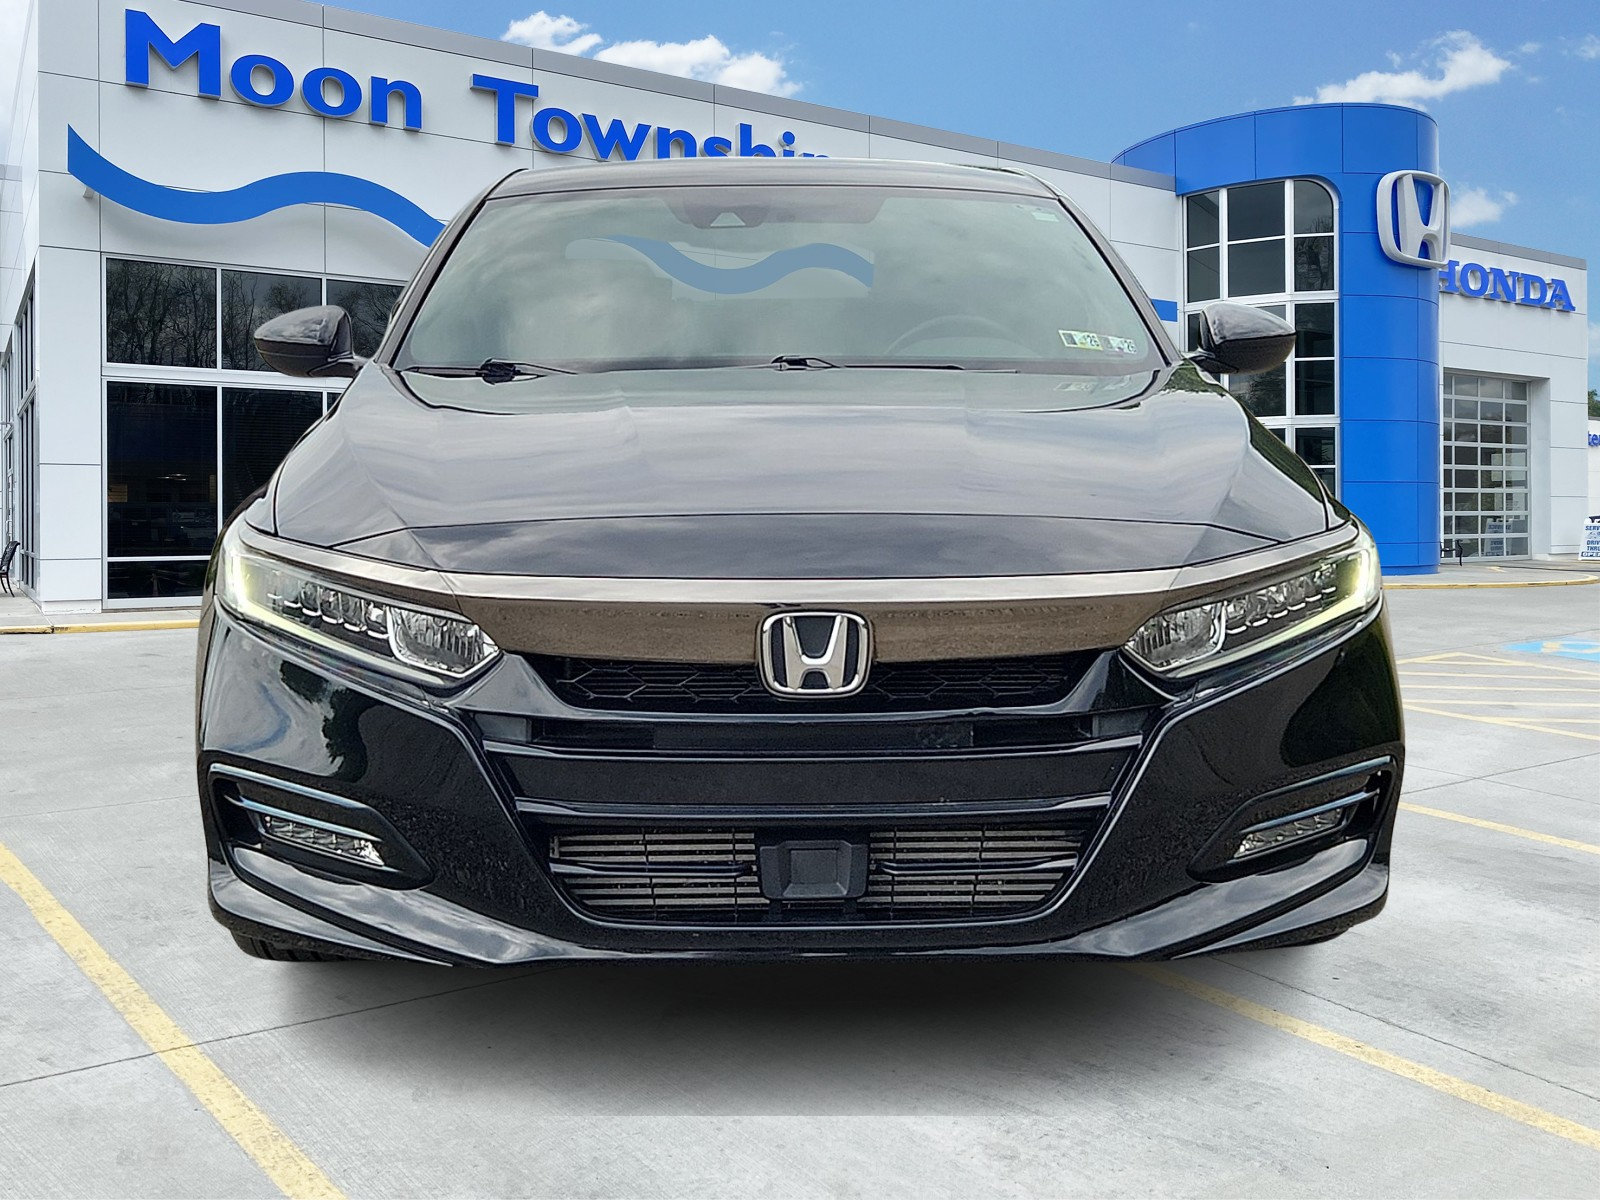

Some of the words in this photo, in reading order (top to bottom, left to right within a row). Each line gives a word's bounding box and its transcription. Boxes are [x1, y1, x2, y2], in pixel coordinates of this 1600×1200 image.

[125, 9, 422, 131] Moon
[470, 74, 829, 164] Townshi
[1438, 260, 1576, 312] HONDA
